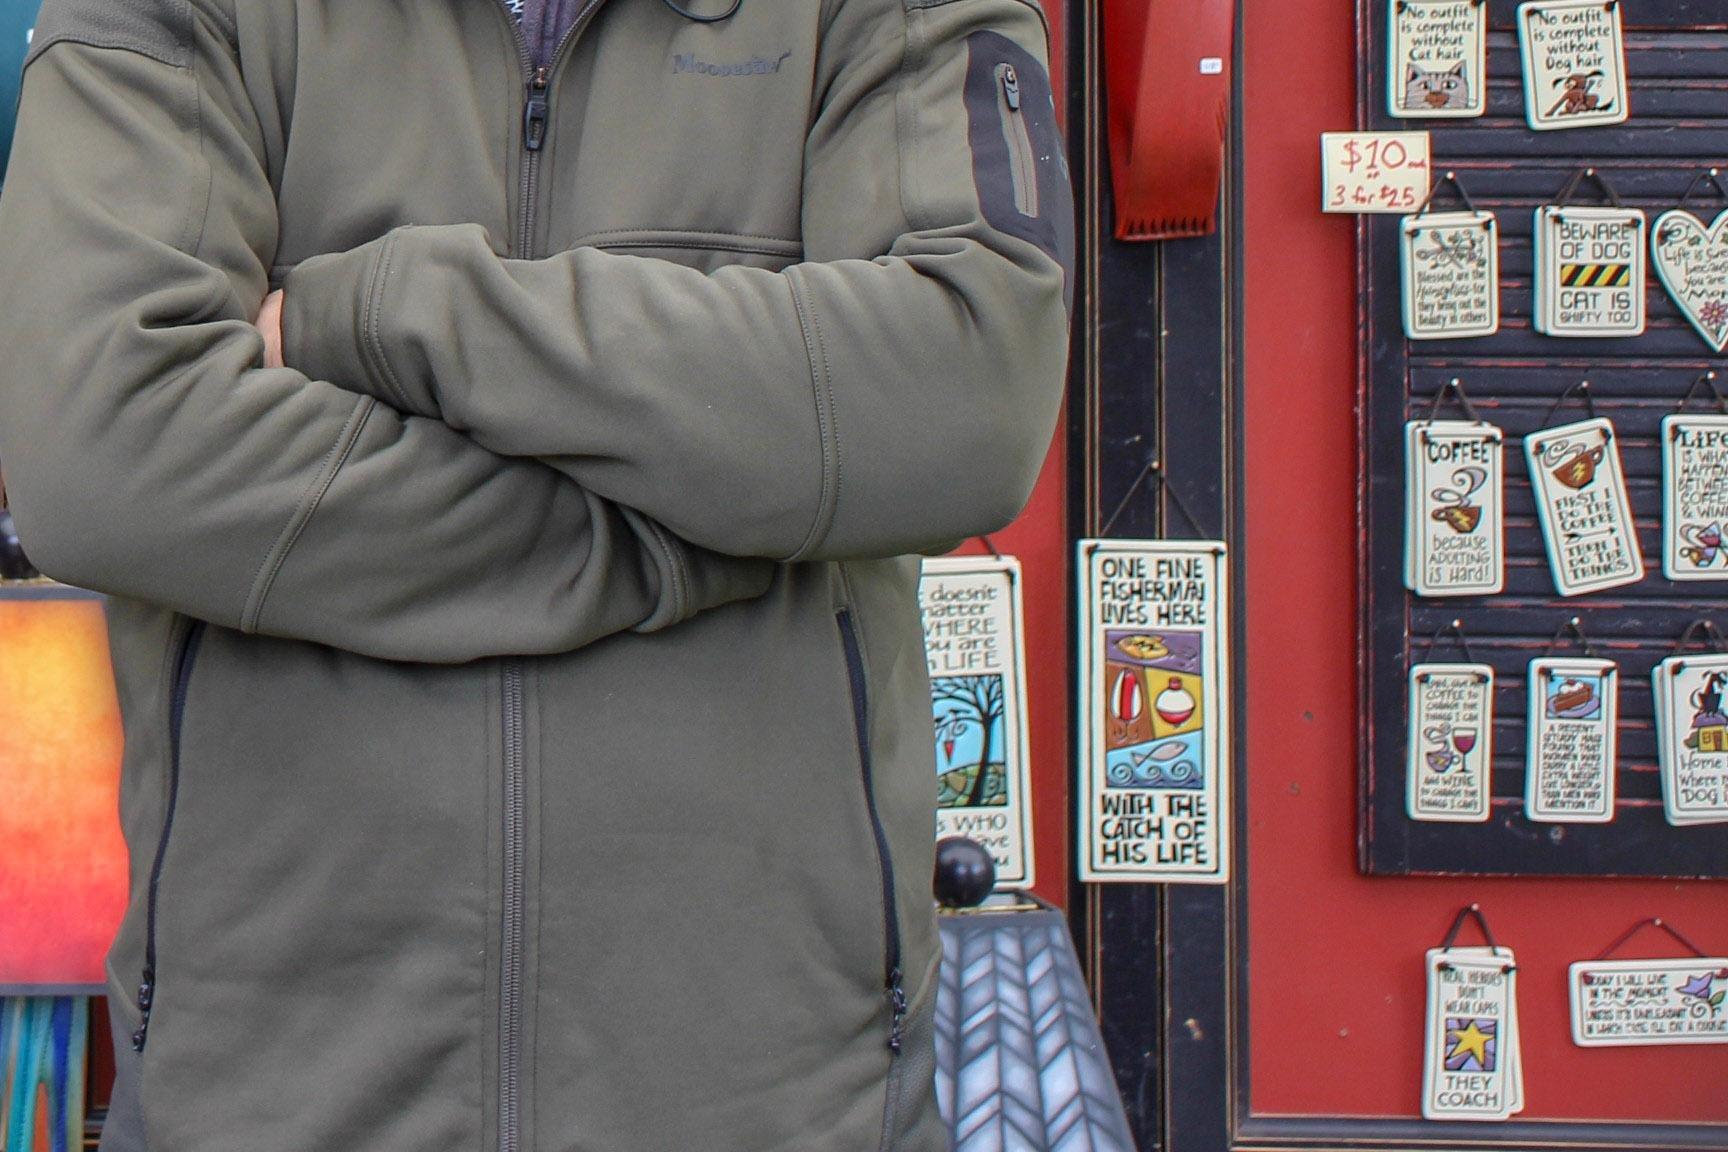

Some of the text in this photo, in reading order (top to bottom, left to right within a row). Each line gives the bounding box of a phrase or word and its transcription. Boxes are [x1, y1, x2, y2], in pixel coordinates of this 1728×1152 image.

[1407, 5, 1469, 18] No outfit
[1402, 20, 1474, 34] is complete
[1412, 34, 1463, 47] without
[1409, 48, 1464, 61] Cat hair
[1341, 140, 1407, 173] $10
[1331, 184, 1415, 205] 3 for $25
[1561, 223, 1630, 240] BEWARE
[1561, 243, 1630, 258] OF DOG
[1561, 291, 1630, 309] CAT IS
[1560, 311, 1630, 323] SHIFTY TOO
[1428, 441, 1489, 464] COFFEE
[1433, 535, 1487, 550] because
[1429, 550, 1490, 565] ADULTING
[1102, 559, 1202, 579] ONE FINE
[1429, 567, 1443, 582] is
[1102, 581, 1205, 602] FISHERMAN
[1102, 605, 1205, 624] LIVES HERE
[944, 652, 999, 669] LIFE
[1102, 793, 1207, 816] WITH THE
[954, 815, 1006, 831] WHO
[1102, 817, 1206, 839] CATCH OF
[1103, 844, 1207, 864] HIS LIFE
[1447, 1076, 1493, 1090] THEY
[1438, 1092, 1497, 1107] COACH
